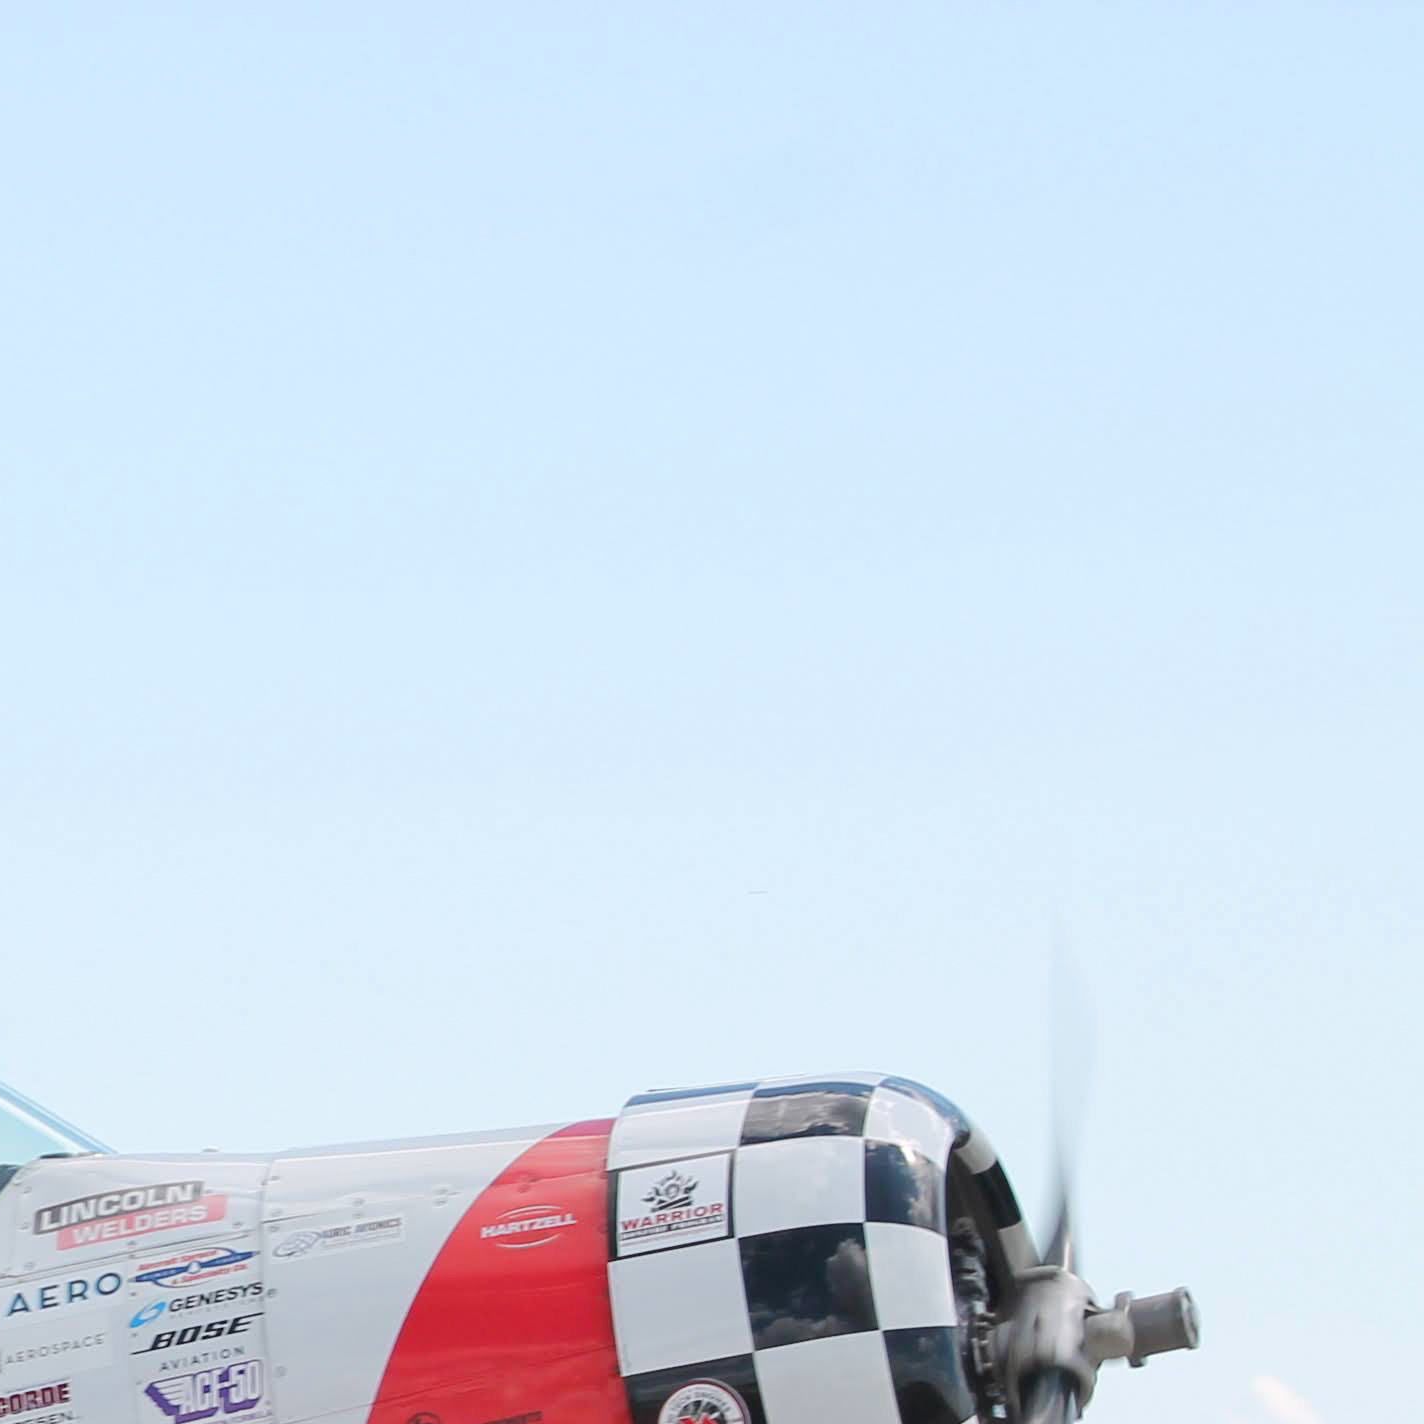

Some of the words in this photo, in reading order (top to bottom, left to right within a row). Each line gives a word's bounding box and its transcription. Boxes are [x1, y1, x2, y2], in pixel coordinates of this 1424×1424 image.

[40, 1182, 194, 1231] LINCOLN
[620, 1203, 724, 1231] WARRIOR
[72, 1205, 207, 1245] WELDERS
[480, 1213, 577, 1239] HARTZELL
[6, 1272, 122, 1317] AERO
[169, 1282, 264, 1312] GENESYS
[6, 1332, 107, 1365] AEROSPACE
[130, 1312, 265, 1355] BOSE
[159, 1346, 245, 1371] AVIATION
